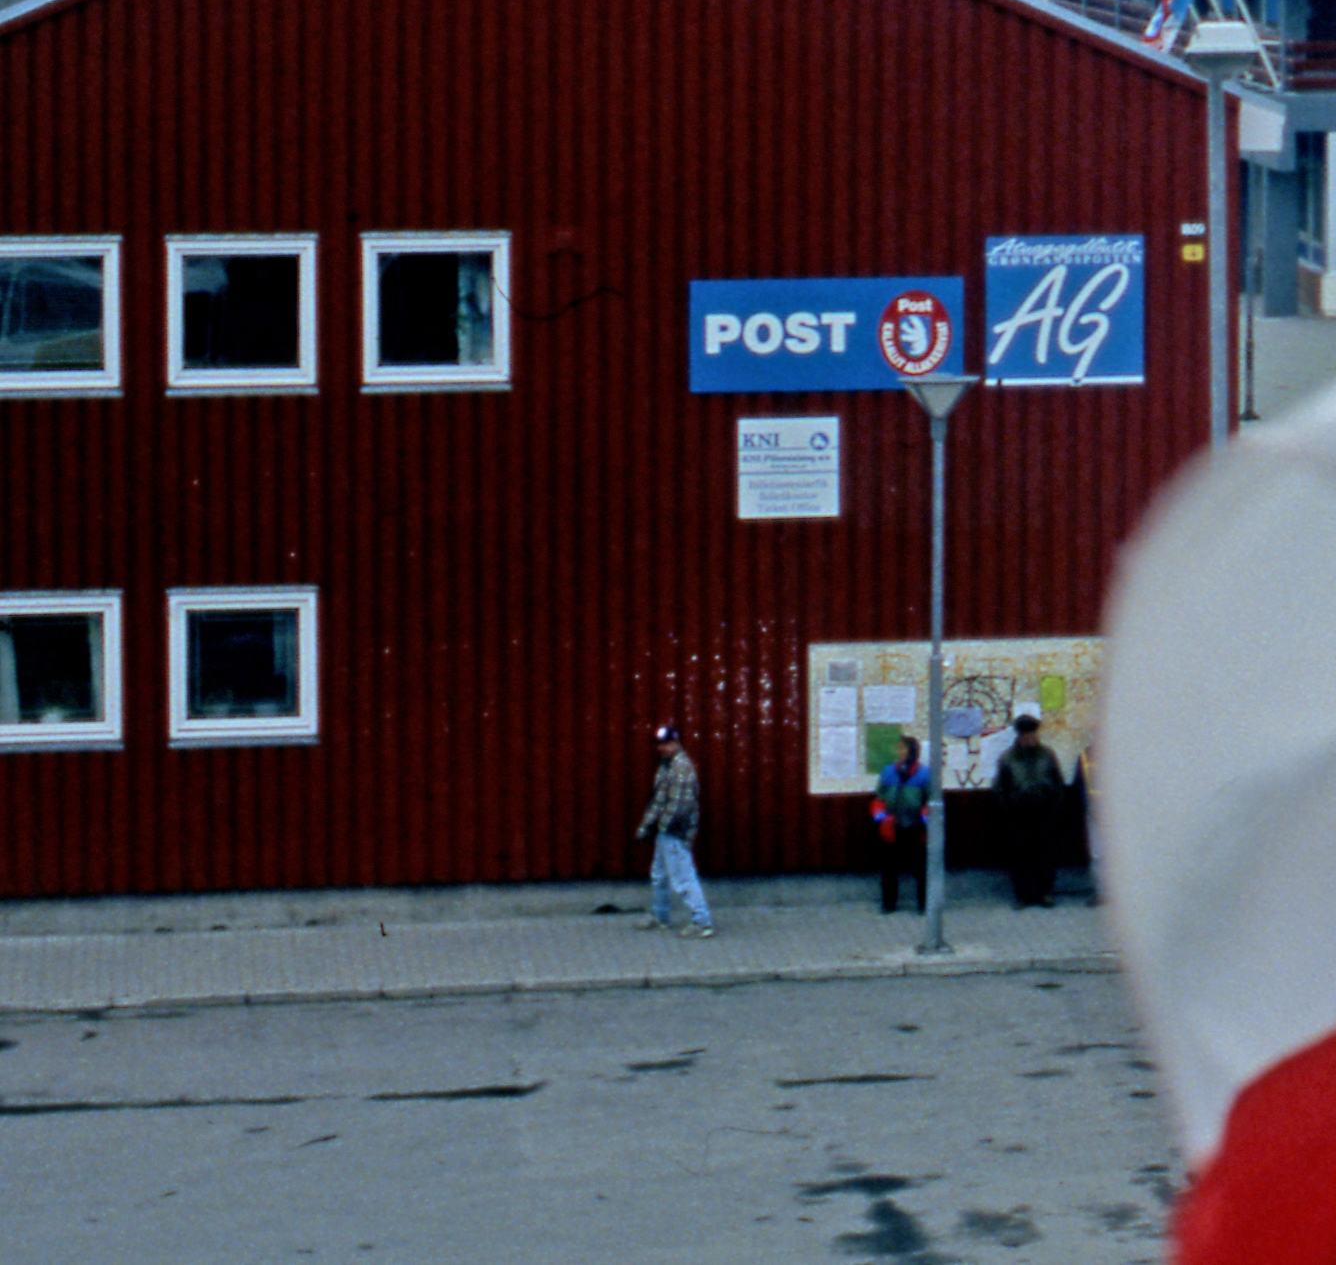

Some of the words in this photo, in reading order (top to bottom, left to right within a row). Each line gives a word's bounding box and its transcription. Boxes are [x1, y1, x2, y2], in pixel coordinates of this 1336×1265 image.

[898, 298, 932, 312] Post
[705, 312, 857, 354] POST
[988, 264, 1130, 382] AG
[743, 434, 779, 447] KNI
